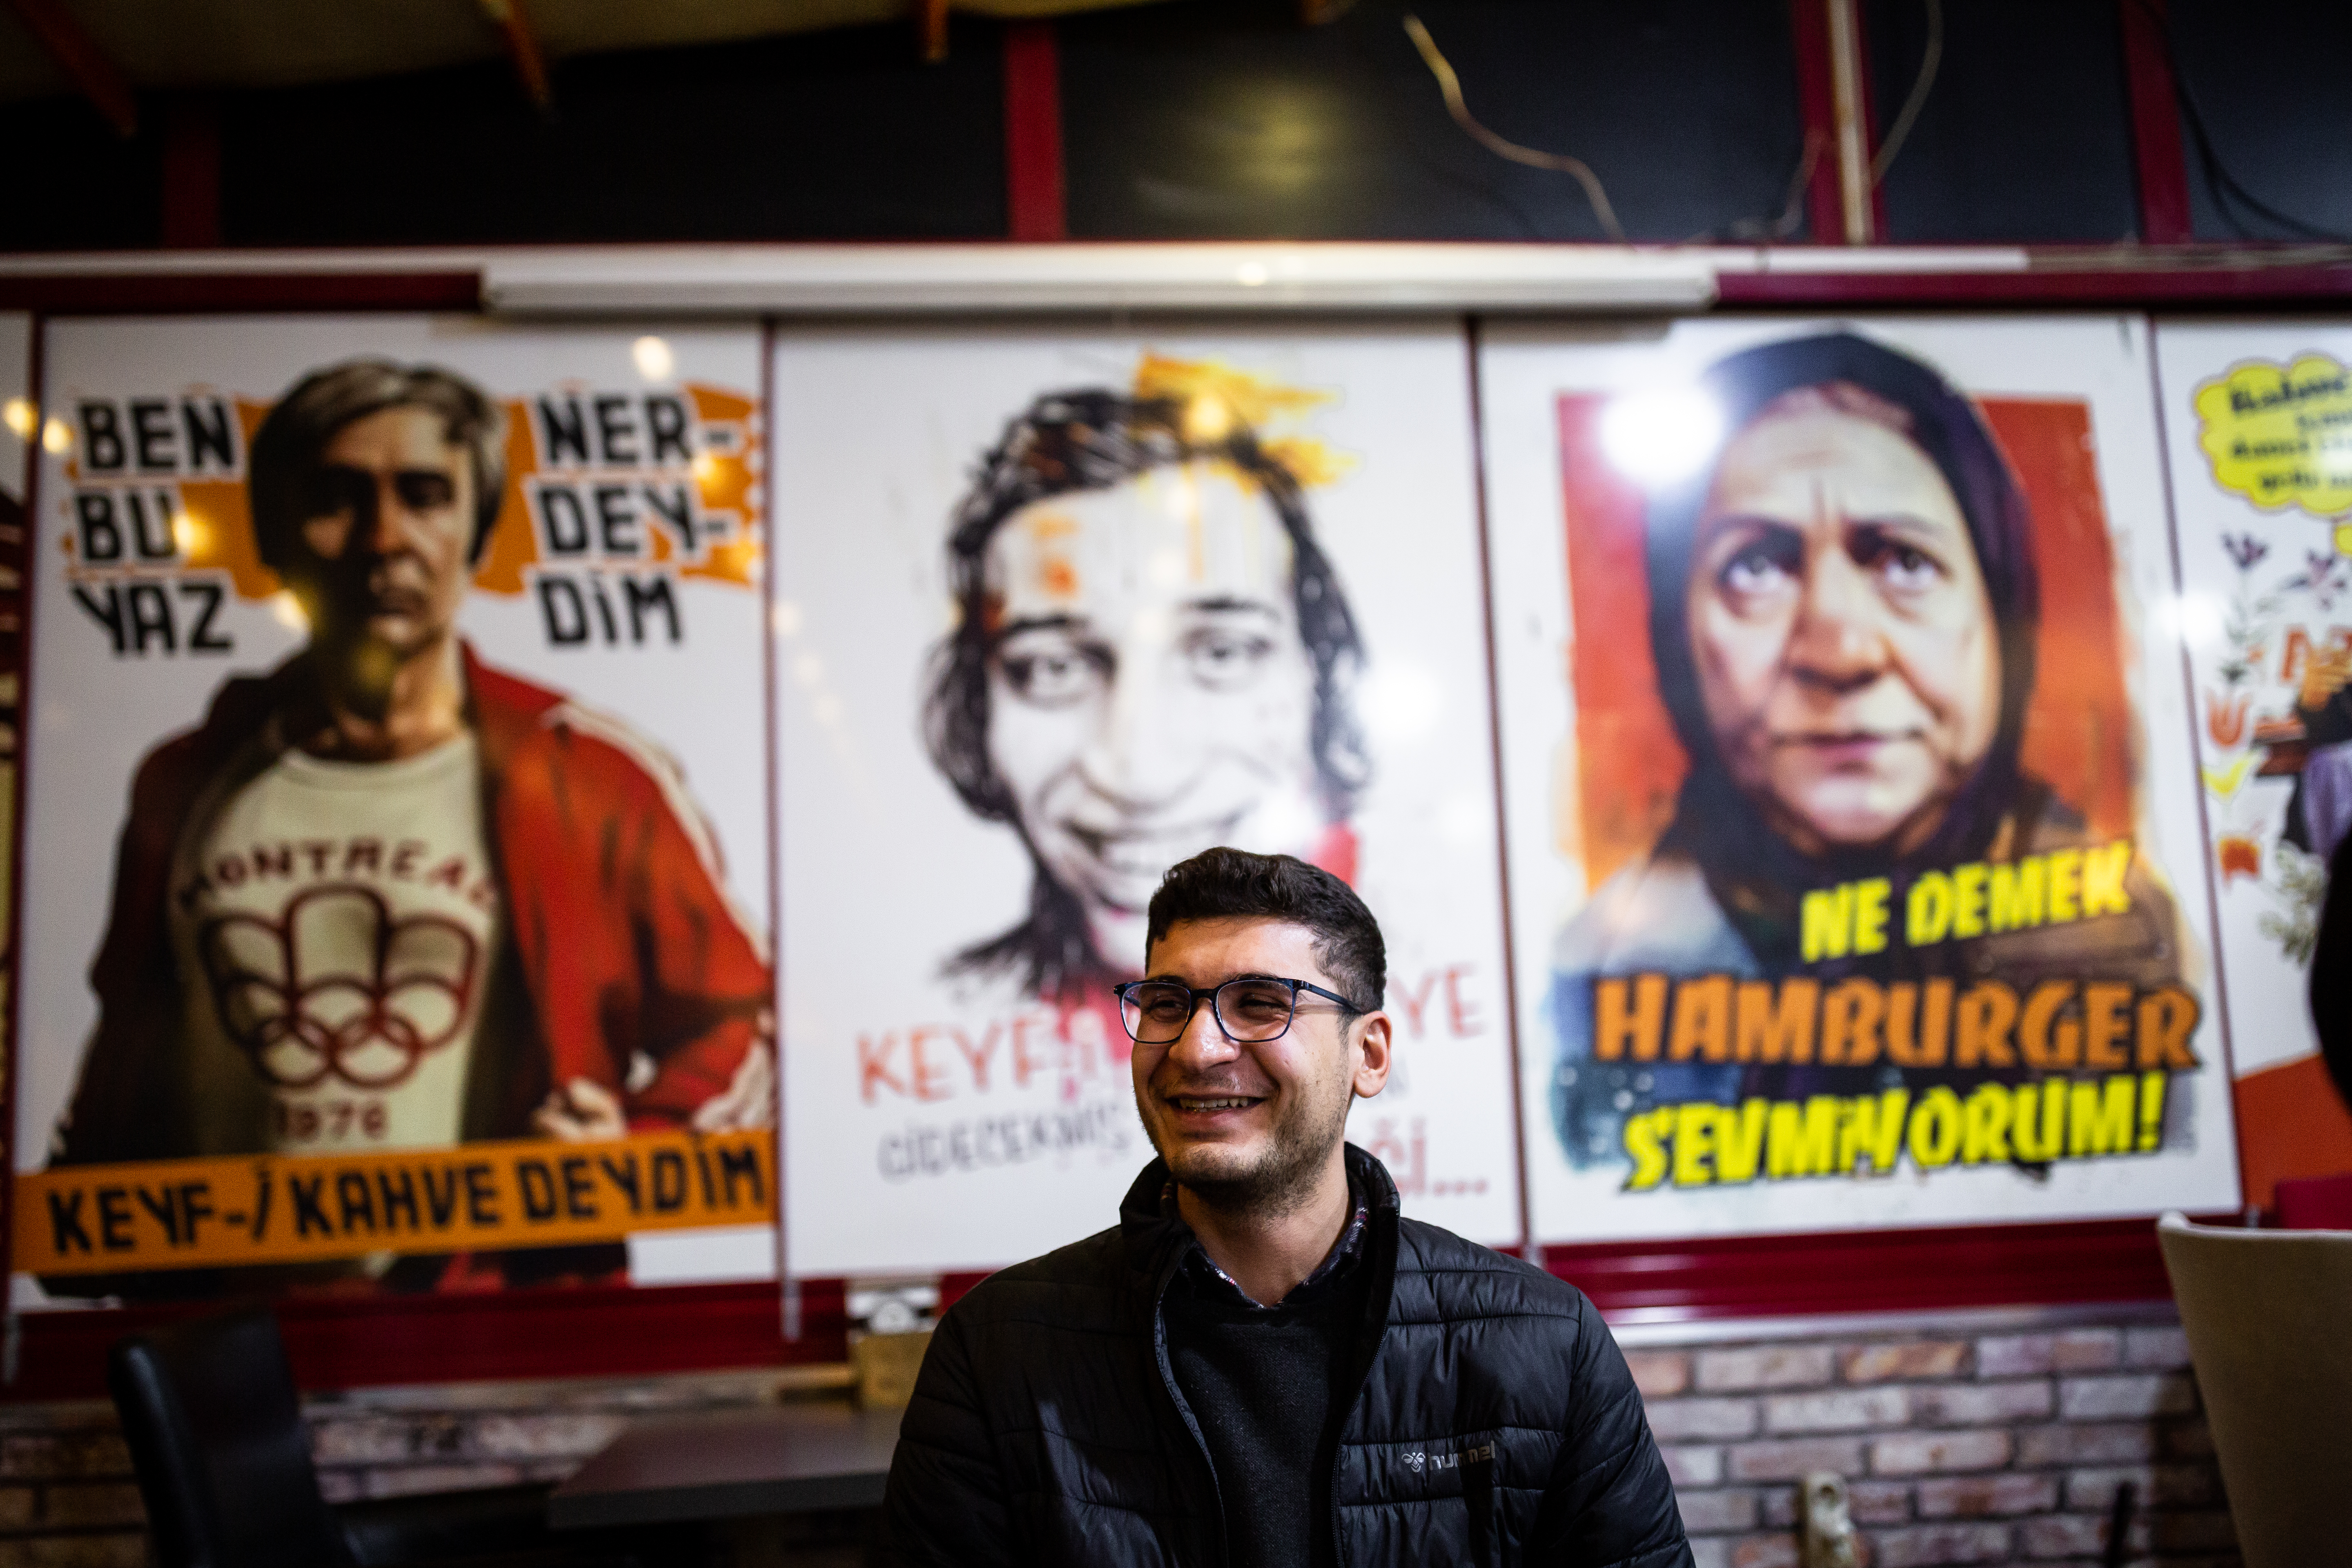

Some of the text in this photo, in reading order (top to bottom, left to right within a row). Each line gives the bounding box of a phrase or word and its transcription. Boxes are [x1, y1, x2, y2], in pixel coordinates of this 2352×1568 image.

[79, 397, 236, 470] BEN
[77, 491, 176, 560] BU
[71, 580, 236, 657] YAZ
[1800, 840, 2132, 963] NE DEMEK
[1593, 971, 2202, 1069] HAMBURGER
[276, 1098, 390, 1140] 1976
[290, 1164, 500, 1237] KAHVE
[1428, 1440, 1495, 1470] hummel
